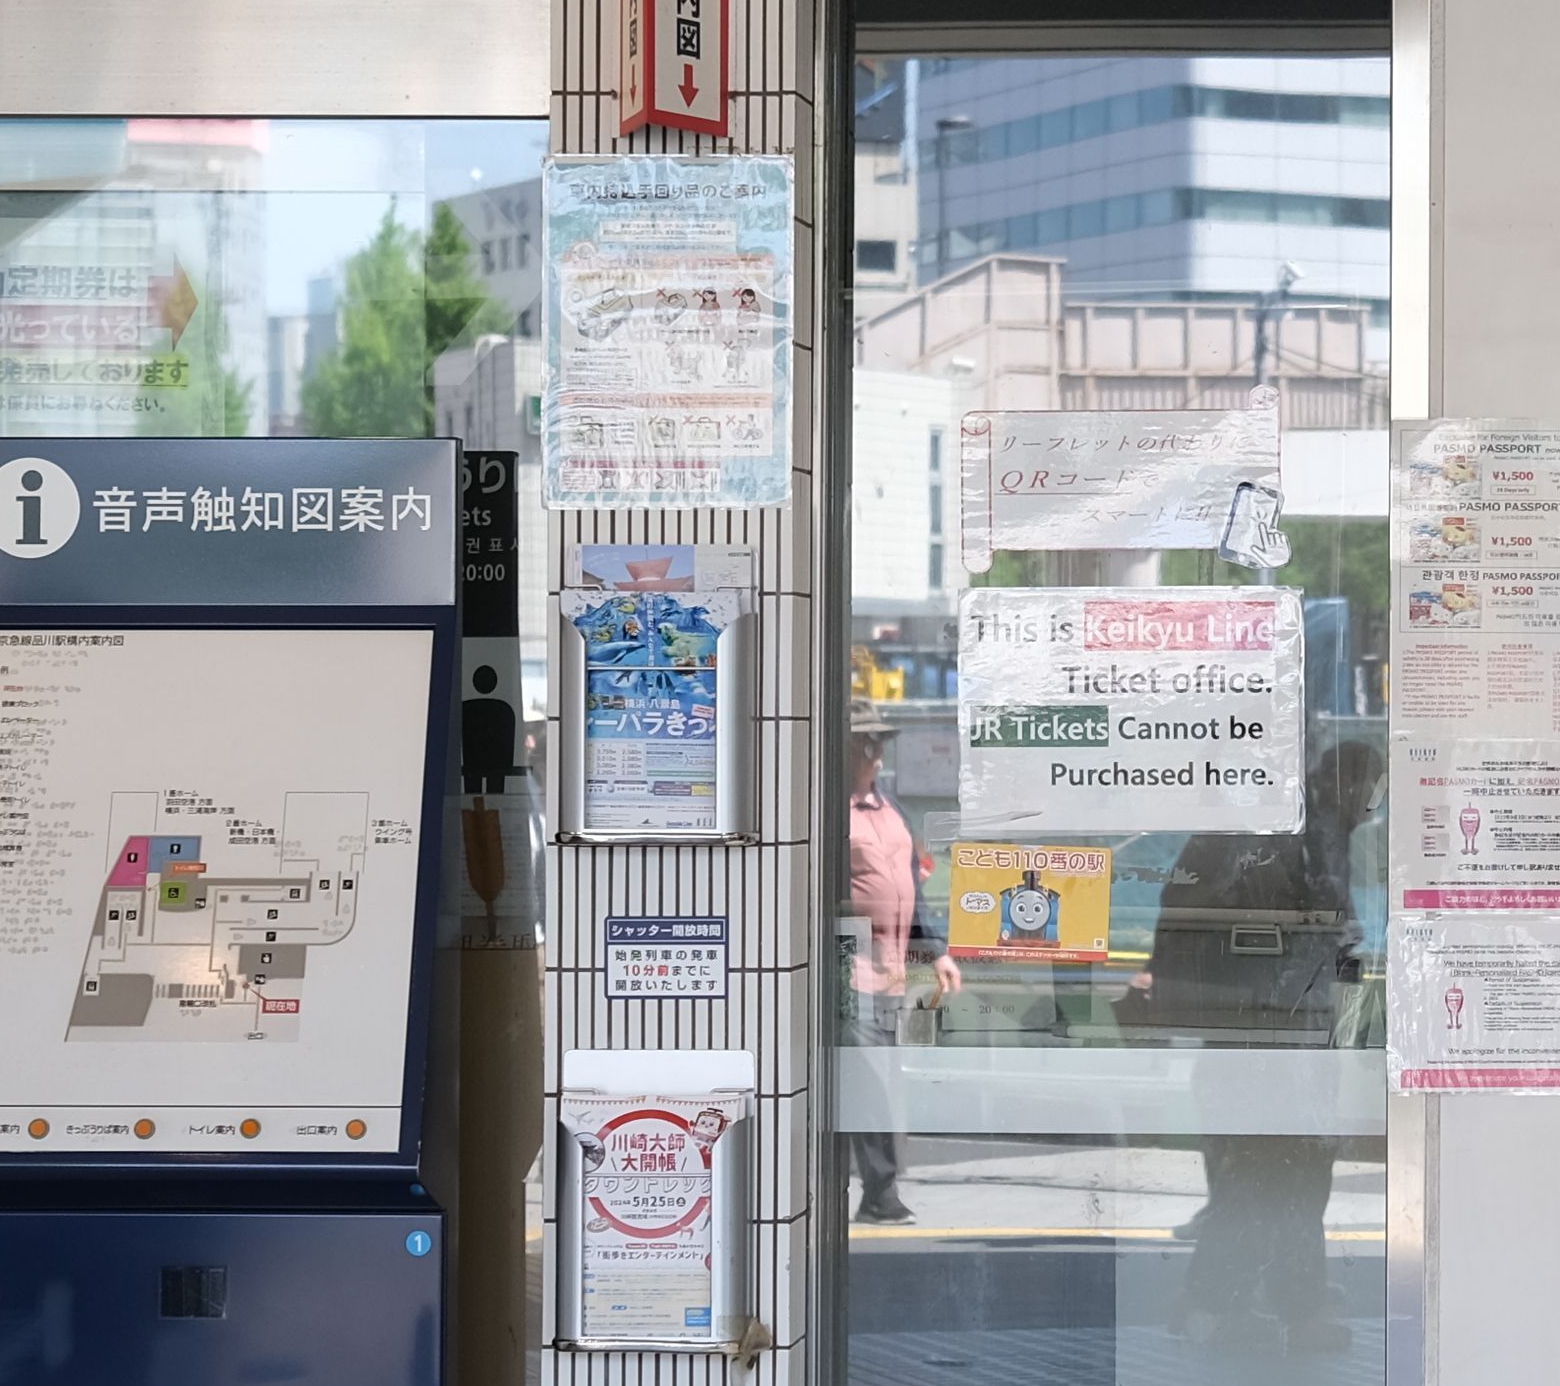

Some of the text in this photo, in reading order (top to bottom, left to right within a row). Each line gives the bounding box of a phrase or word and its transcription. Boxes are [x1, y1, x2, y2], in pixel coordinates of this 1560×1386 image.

[1480, 444, 1541, 453] PASSPORT
[1493, 472, 1533, 482] ¥1,500
[92, 485, 434, 533] 音声触知図案内
[1492, 586, 1533, 596] ¥1,500
[971, 614, 1274, 649] This is Keikyu Line
[1062, 665, 1272, 694] Ticket office.
[971, 716, 1262, 741] JR Tickets Cannot be
[1052, 762, 1273, 785] Purchased here.
[958, 850, 1105, 871] こども110番の駅
[612, 925, 720, 936] シャッター開放時間
[623, 965, 710, 976] 10分前までに
[611, 1134, 685, 1152] 川崎大師
[621, 1153, 677, 1172] 大開帳
